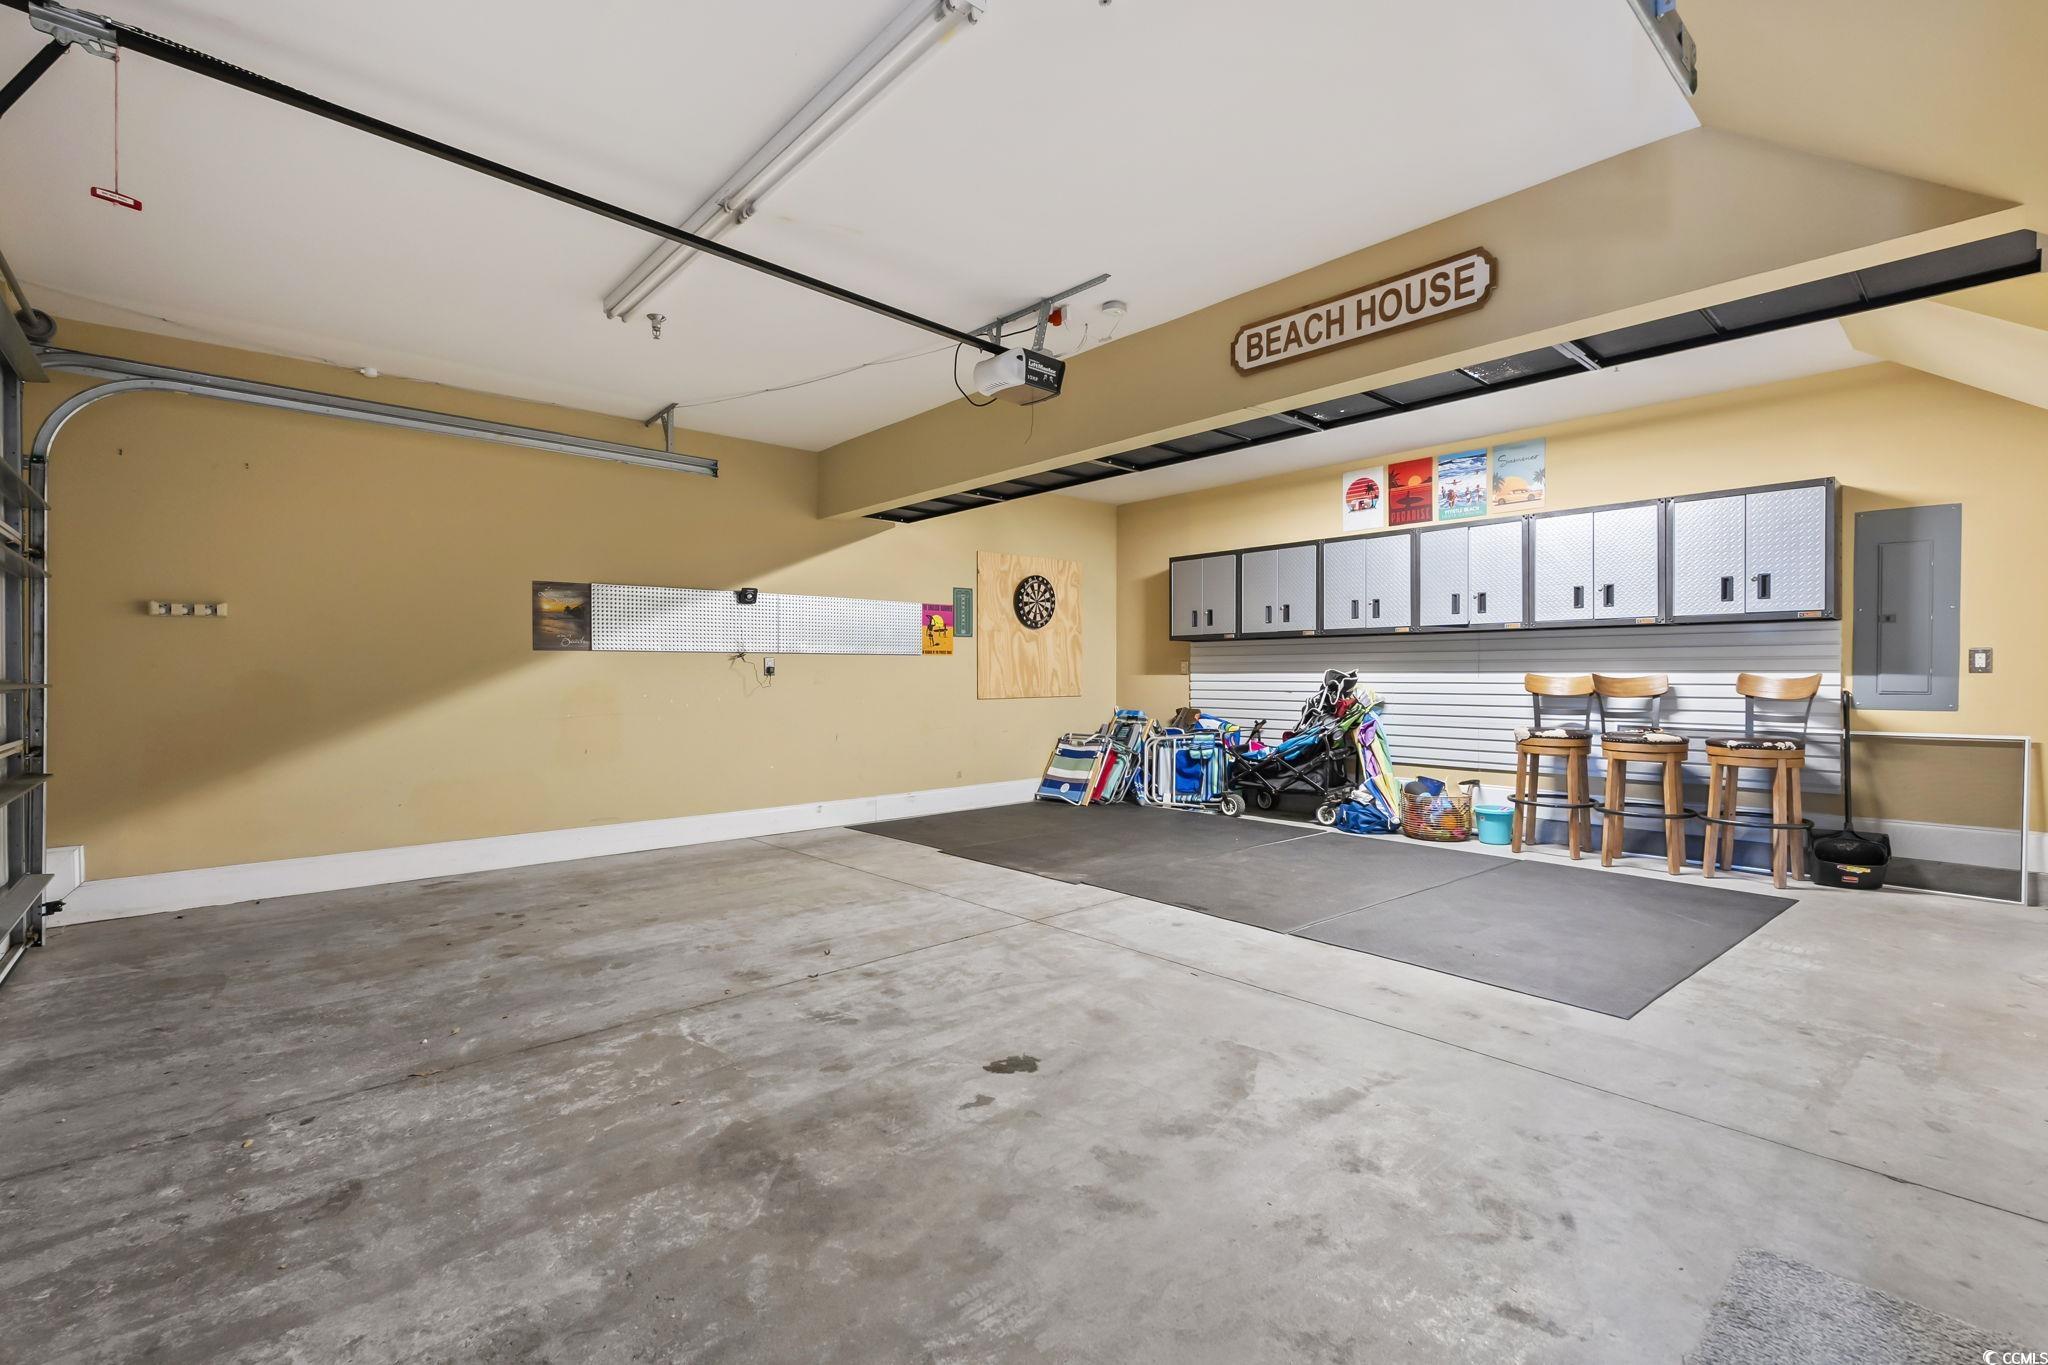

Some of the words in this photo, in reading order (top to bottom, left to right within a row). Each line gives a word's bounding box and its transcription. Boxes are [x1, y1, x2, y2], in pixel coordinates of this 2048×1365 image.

[1246, 304, 1345, 363] BEACH
[1356, 261, 1476, 331] HOUSE
[1391, 508, 1431, 523] PARADISE
